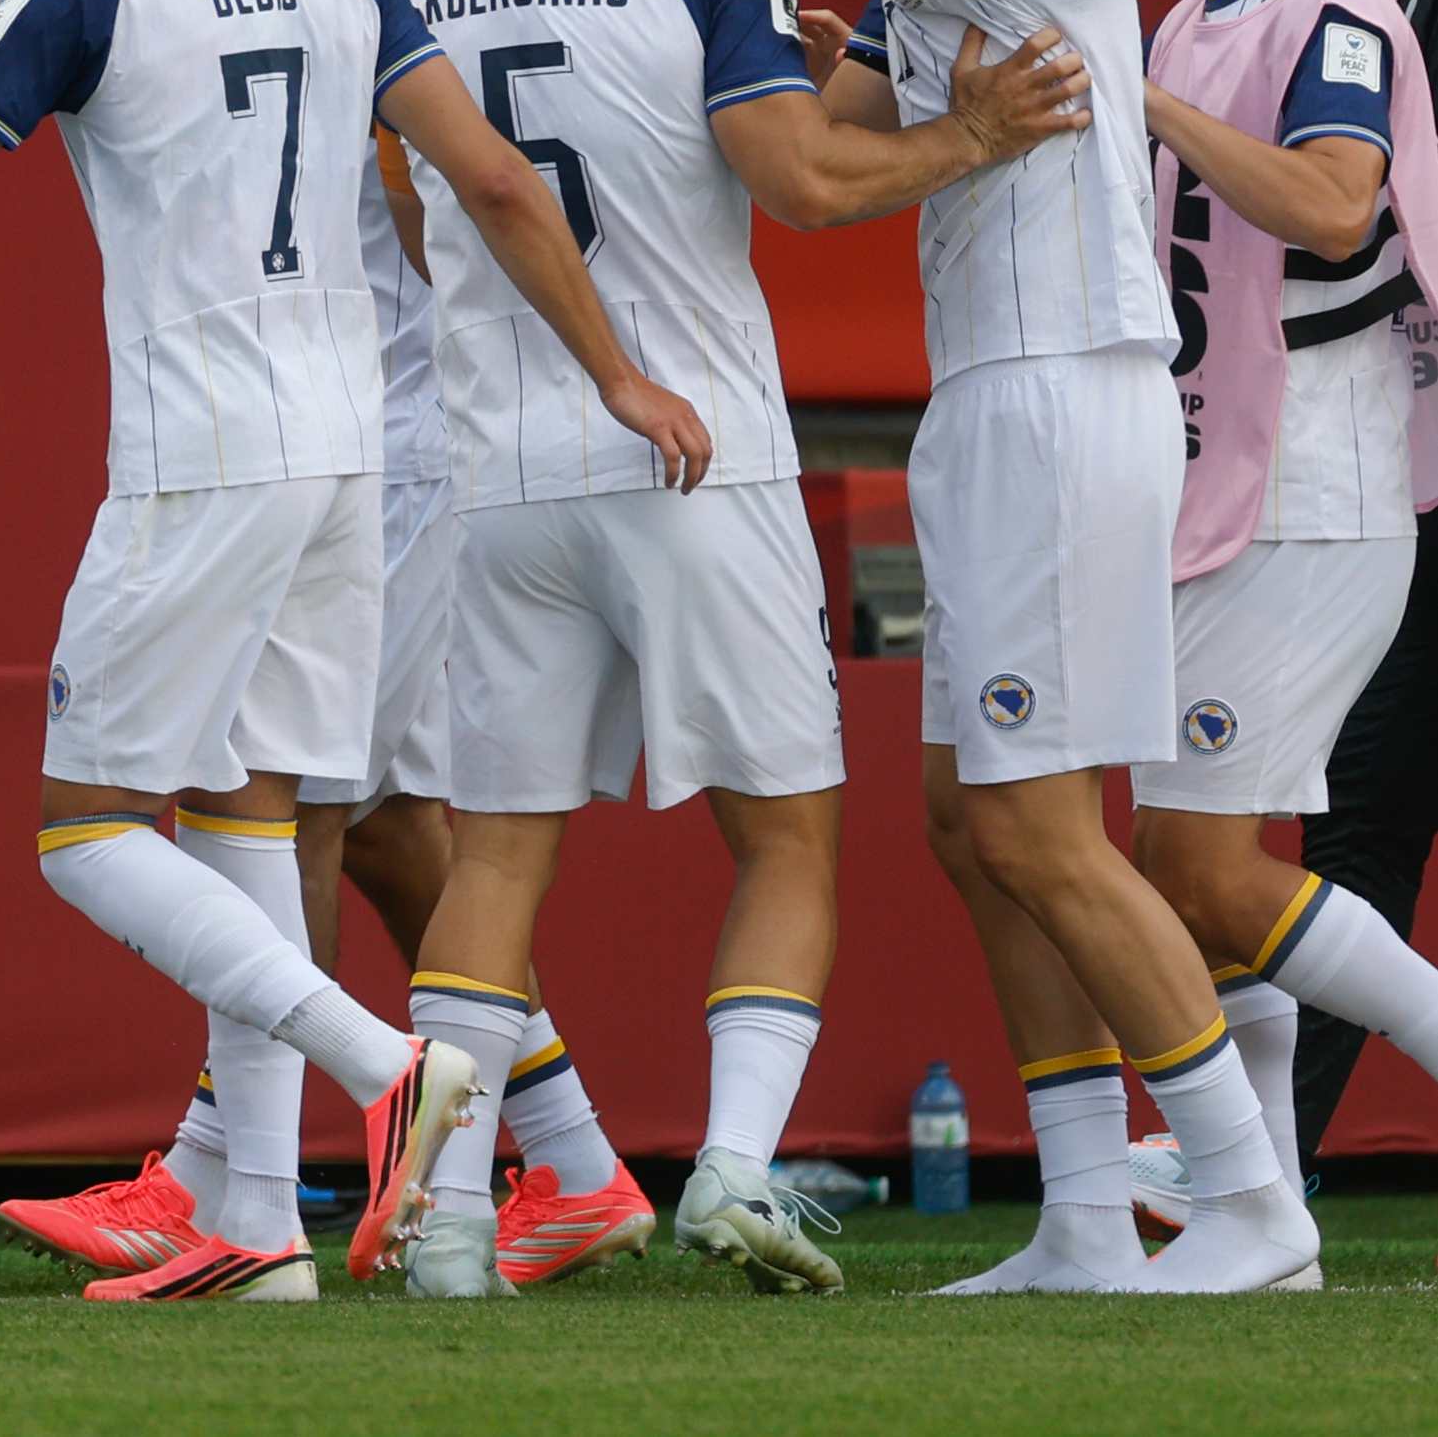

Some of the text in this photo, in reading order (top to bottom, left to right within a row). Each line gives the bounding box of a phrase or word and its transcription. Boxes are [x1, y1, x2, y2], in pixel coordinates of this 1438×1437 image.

[220, 47, 310, 282] 7
[480, 41, 605, 267] 5
[1340, 59, 1366, 74] PEACE
